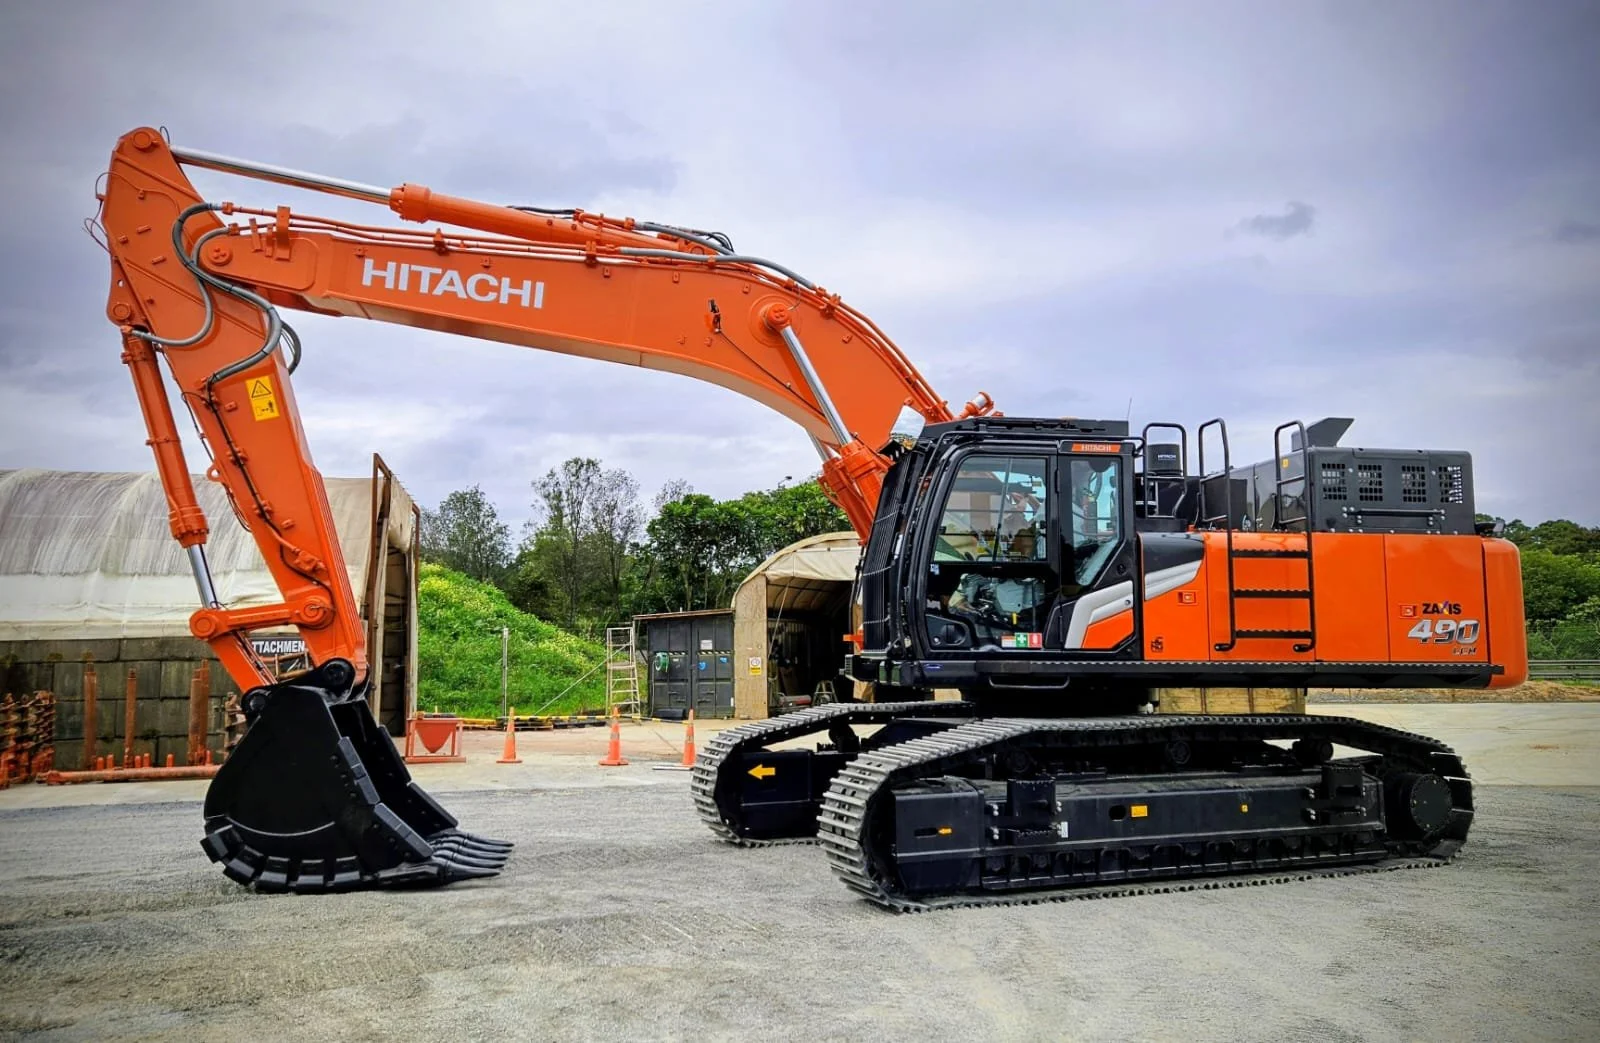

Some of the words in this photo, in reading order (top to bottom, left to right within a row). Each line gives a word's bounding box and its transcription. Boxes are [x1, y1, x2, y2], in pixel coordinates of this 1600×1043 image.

[362, 258, 545, 309] HITACHI
[1081, 444, 1112, 452] HITACHI
[1422, 601, 1462, 615] ZAXIS
[1407, 619, 1480, 644] 490
[252, 640, 305, 653] TTACHMEN
